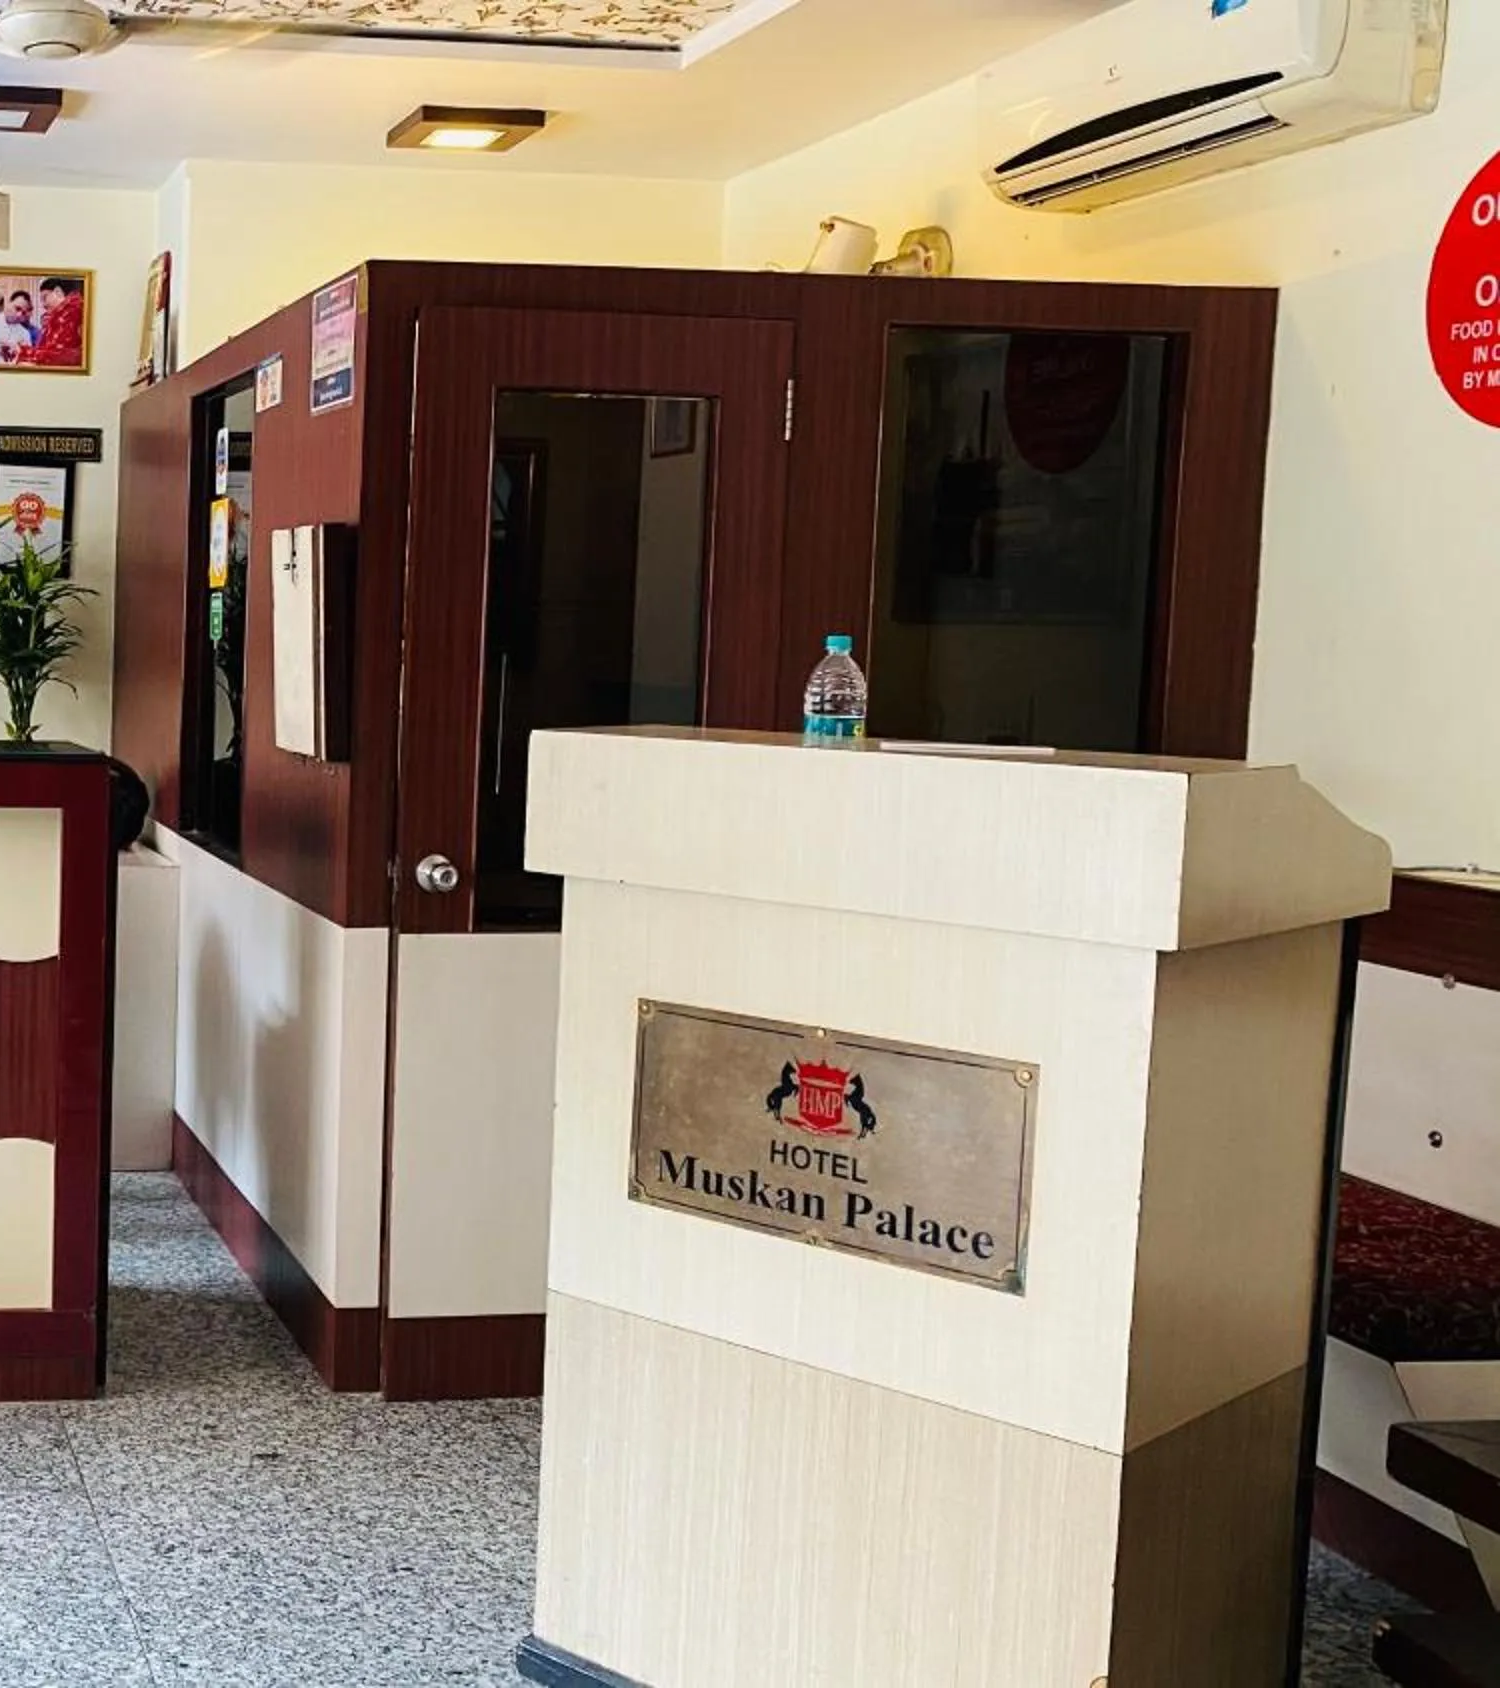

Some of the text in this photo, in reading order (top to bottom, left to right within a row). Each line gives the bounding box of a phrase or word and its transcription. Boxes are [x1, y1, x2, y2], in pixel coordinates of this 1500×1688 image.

[1450, 319, 1494, 341] FOOD
[1473, 344, 1489, 365] IN
[1463, 370, 1485, 389] BY
[49, 436, 95, 454] RESERVED
[802, 1086, 842, 1120] HMP
[769, 1138, 869, 1185] HOTEL
[658, 1149, 995, 1260] Muskan Palace
